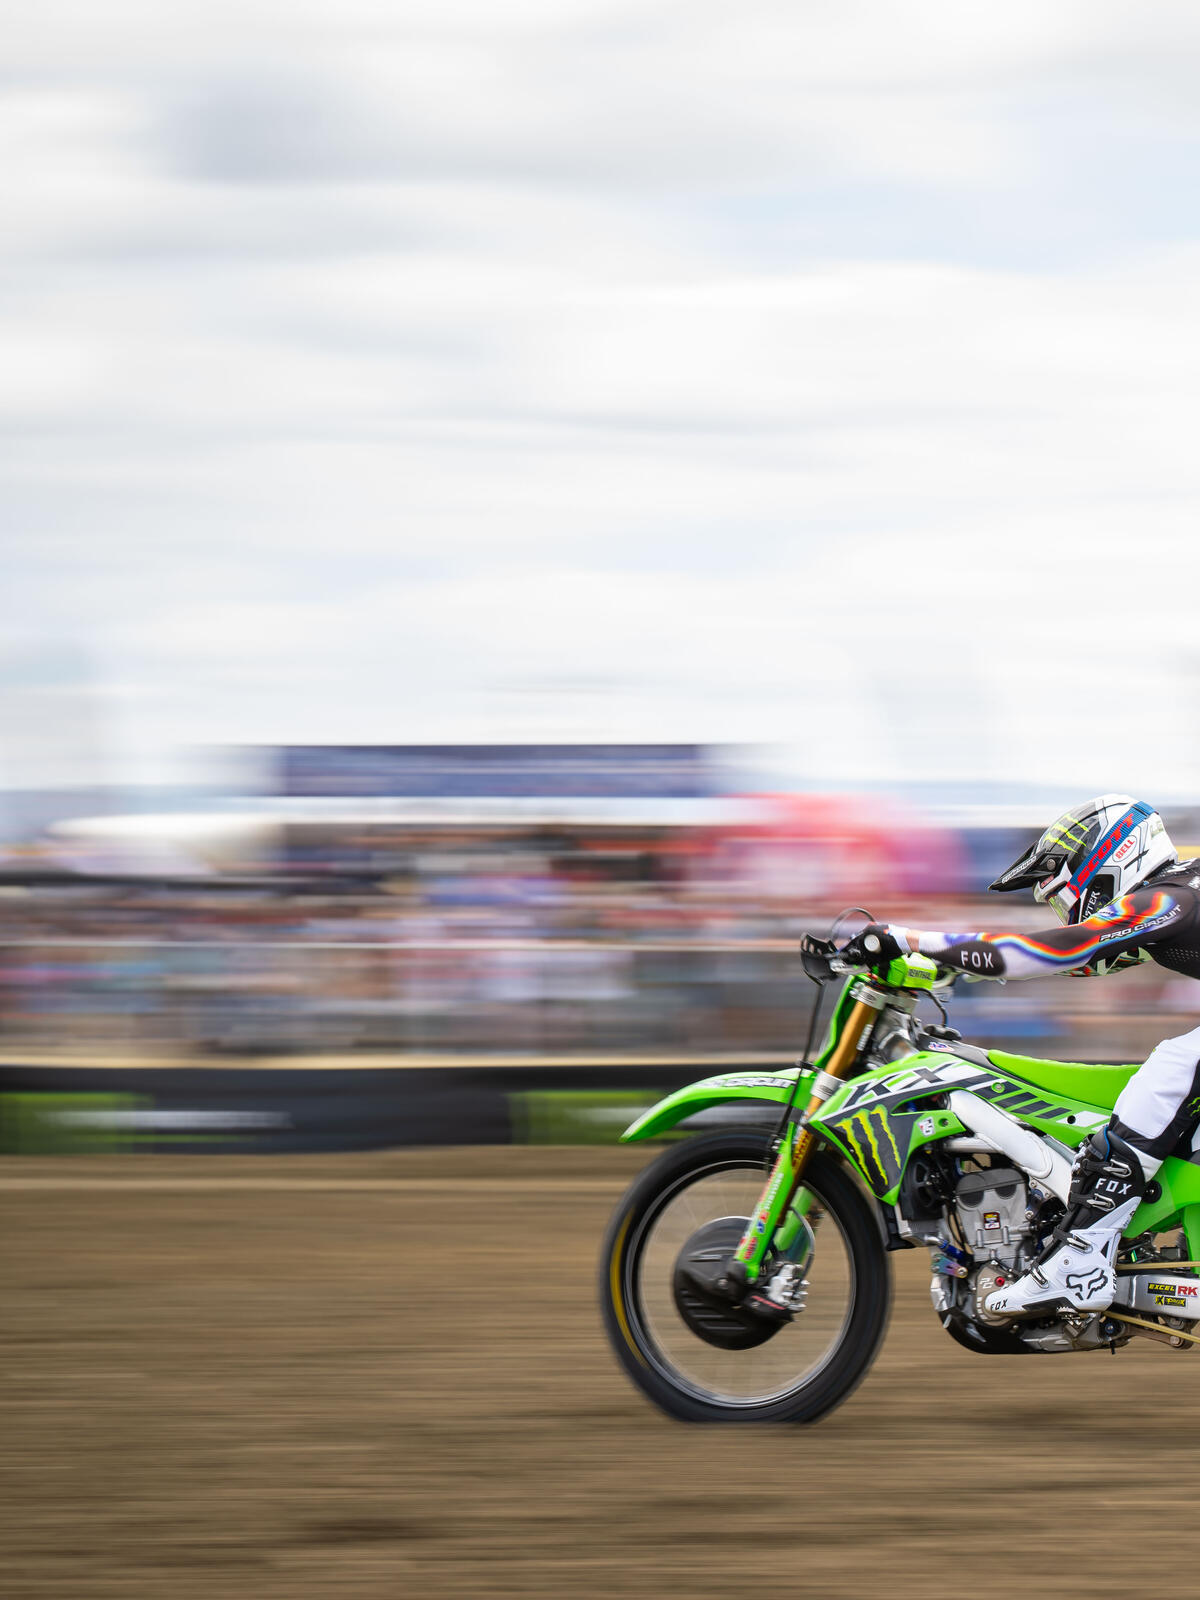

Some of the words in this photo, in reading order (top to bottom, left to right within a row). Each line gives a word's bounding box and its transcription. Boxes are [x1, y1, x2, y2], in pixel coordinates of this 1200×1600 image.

[1077, 813, 1134, 887] SCOTT
[1114, 839, 1136, 860] BELL
[1099, 927, 1132, 942] PRO
[1134, 904, 1182, 932] CIRCUIT
[960, 950, 995, 969] FOX
[1095, 1178, 1132, 1195] FOX
[1148, 1283, 1175, 1292] EXCEL
[1177, 1285, 1198, 1296] RK
[991, 1299, 1008, 1311] FOX
